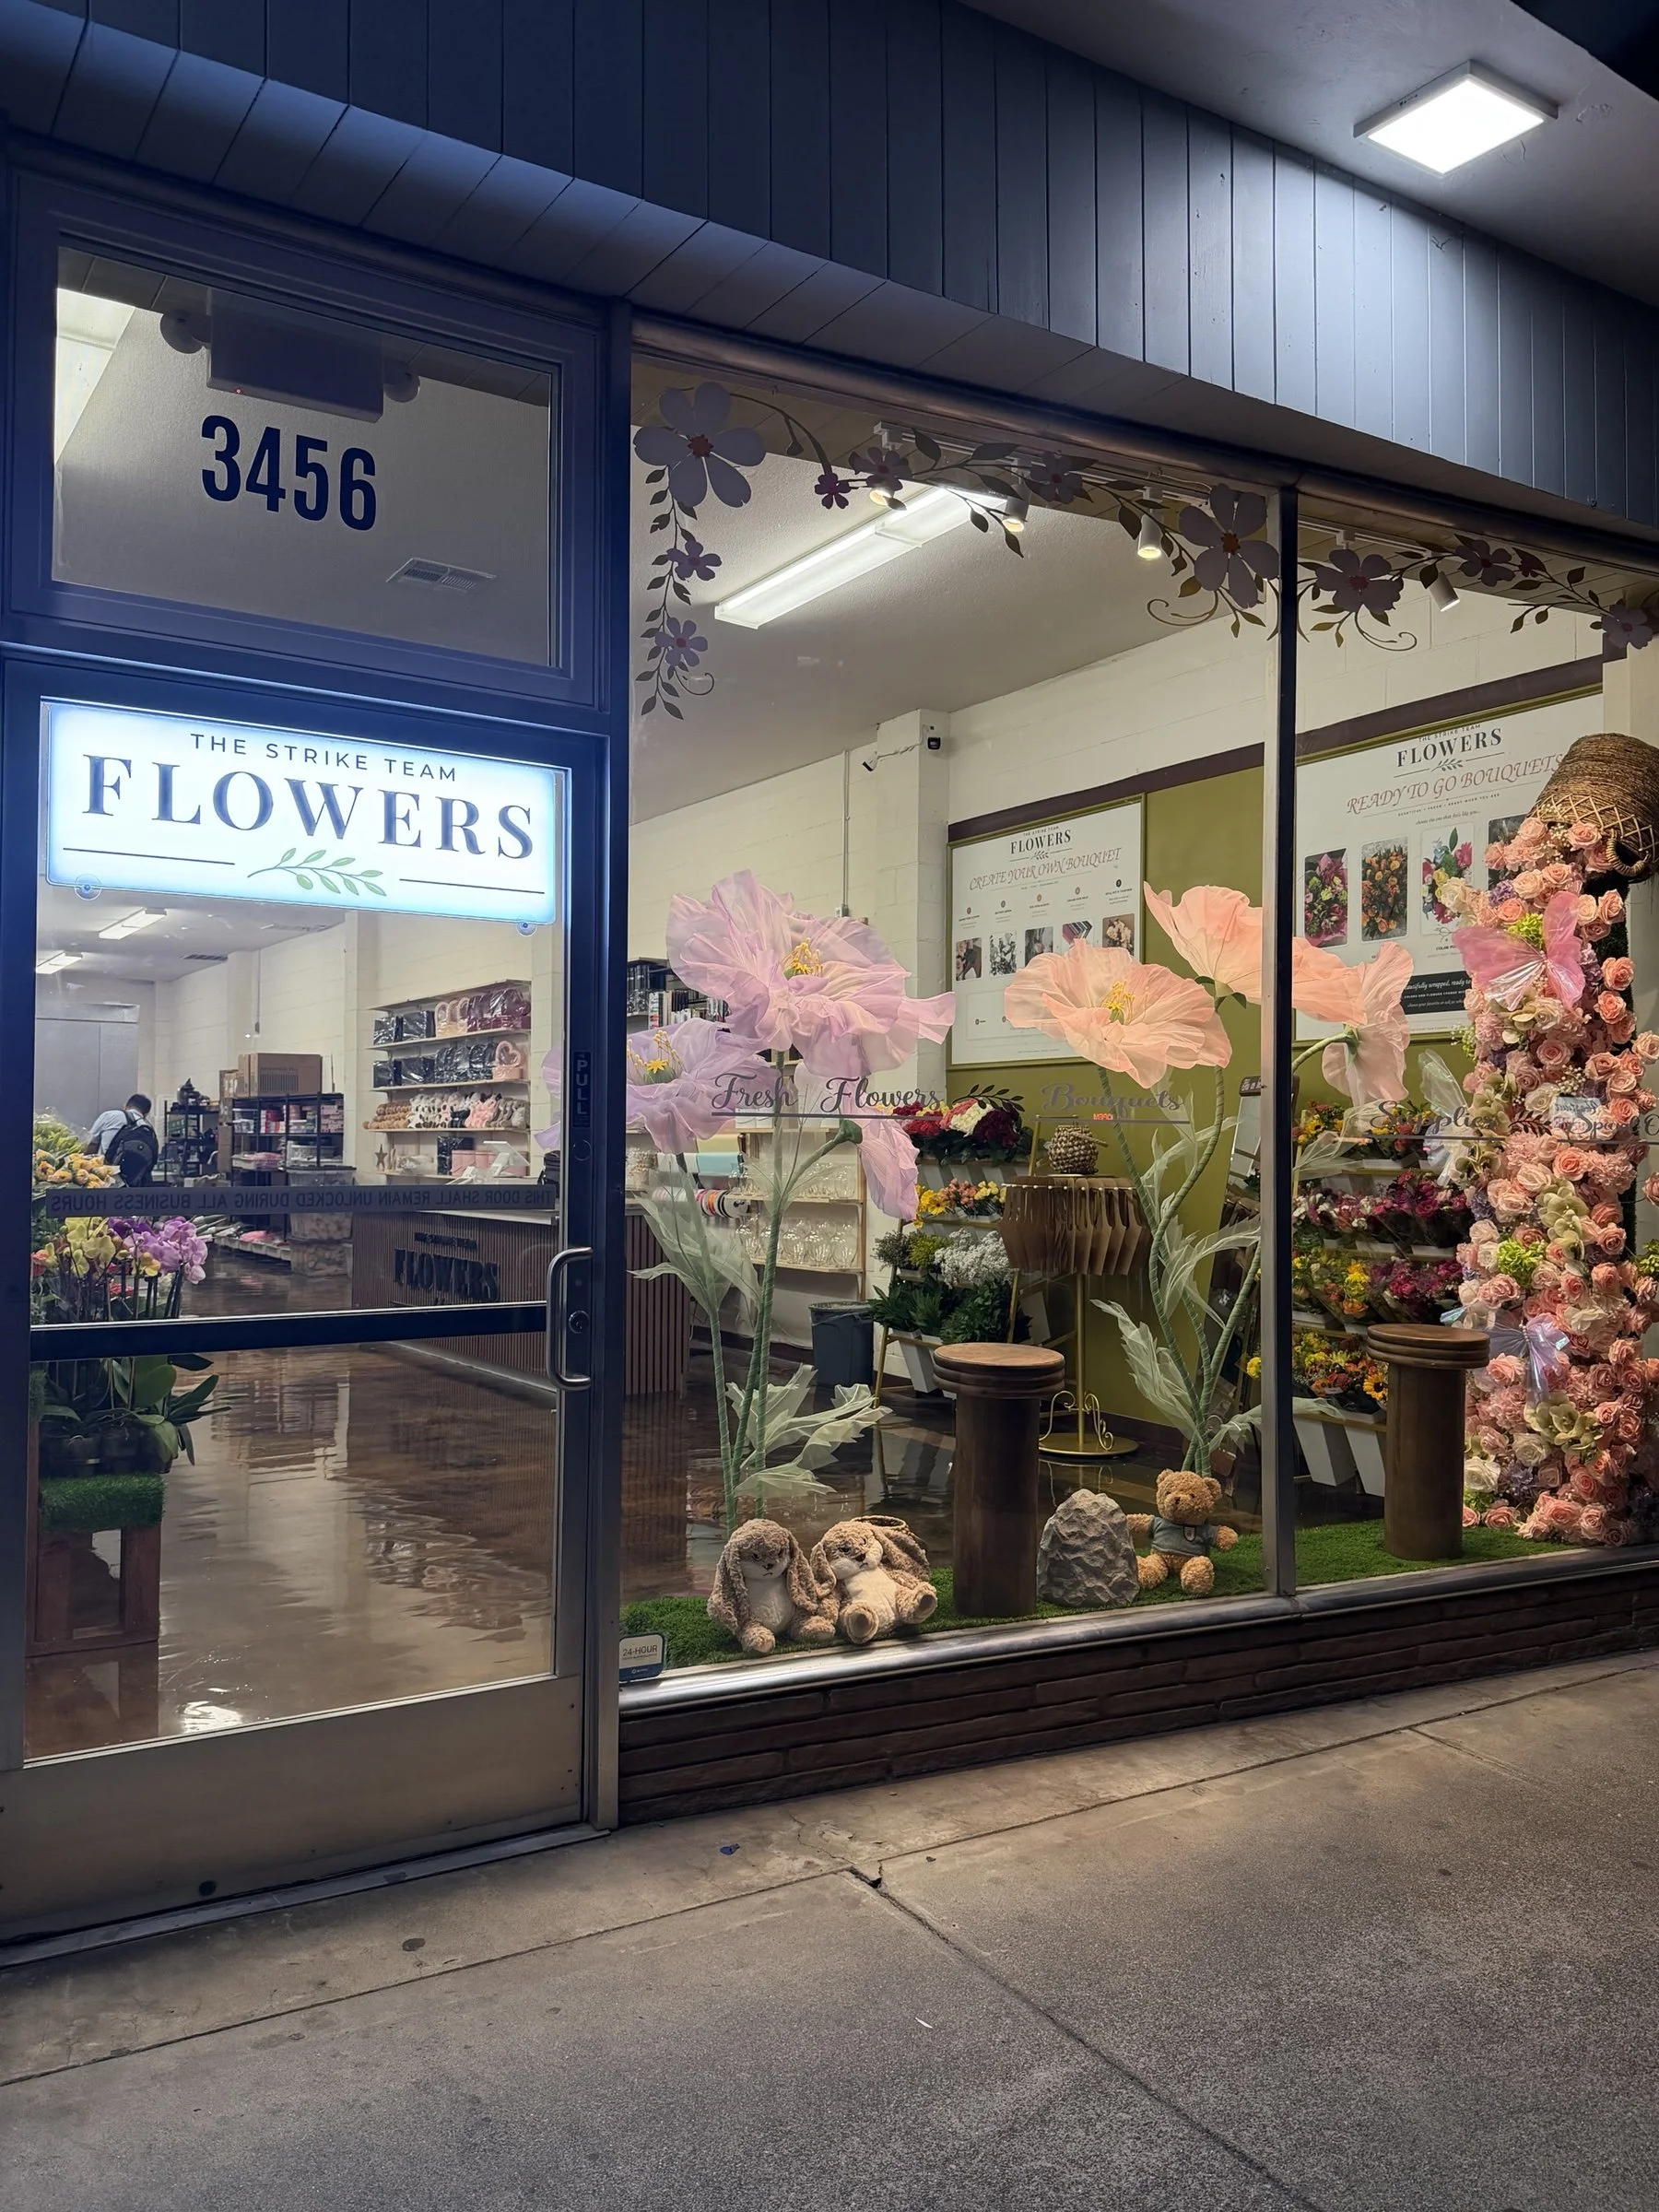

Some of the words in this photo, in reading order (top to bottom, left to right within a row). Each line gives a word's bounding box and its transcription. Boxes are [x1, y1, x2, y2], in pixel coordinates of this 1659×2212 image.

[200, 415, 378, 532] 3456
[1396, 727, 1502, 768] FLOWERS
[1434, 728, 1459, 739] STRIKE
[1462, 724, 1481, 733] TEAM
[190, 733, 246, 757] THE
[265, 742, 369, 771] STRIKE
[384, 758, 457, 782] TEAM
[1346, 784, 1409, 815] READY
[1406, 780, 1429, 801] TO
[1433, 774, 1457, 800] GO
[1460, 753, 1563, 789] BOUQUETS
[82, 753, 535, 860] FLOWERS
[1010, 829, 1071, 854] FLOWERS
[969, 871, 1007, 891] CREATE
[1007, 865, 1038, 885] YOUR
[1038, 857, 1066, 877] OWN
[1065, 847, 1123, 870] BOUQUET
[576, 1060, 588, 1114] PULL
[712, 1072, 798, 1110] Fresh
[819, 1075, 944, 1113] Flowers
[1041, 1082, 1184, 1119] Bouquets
[1369, 1100, 1497, 1135] Supplies
[394, 1248, 500, 1301] FLOWERS
[622, 1645, 657, 1656] 24-HOUR
